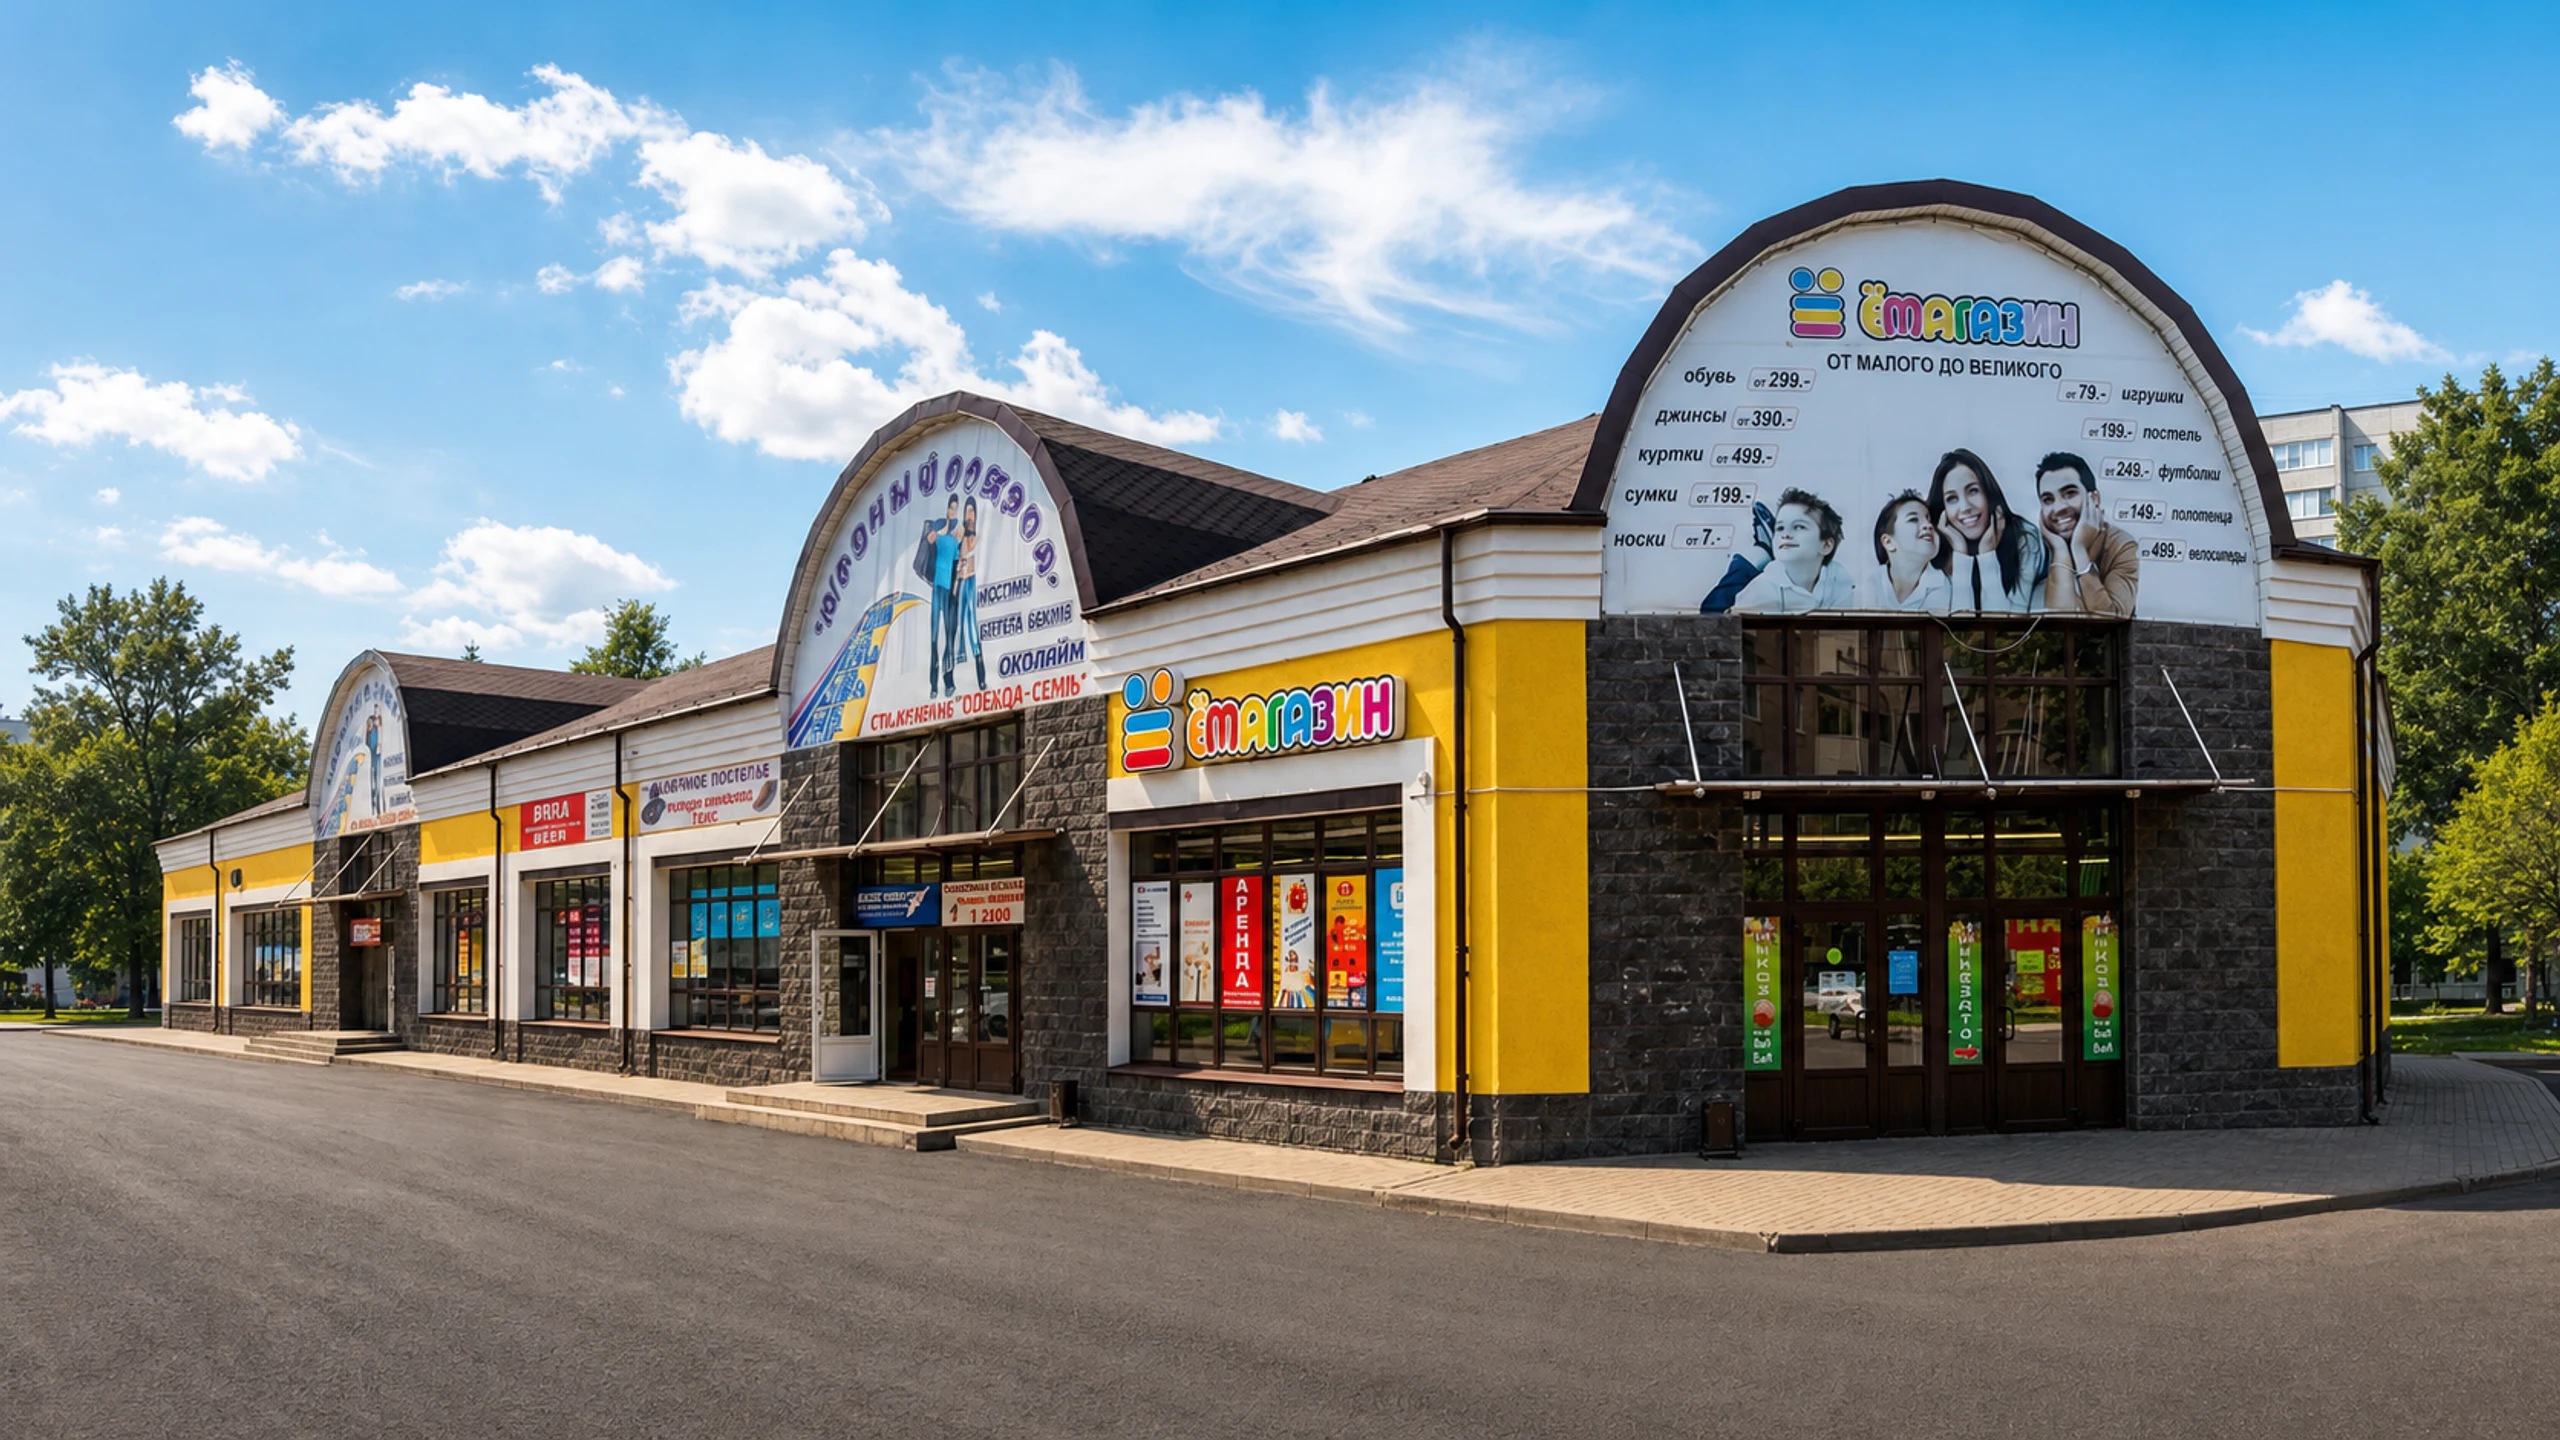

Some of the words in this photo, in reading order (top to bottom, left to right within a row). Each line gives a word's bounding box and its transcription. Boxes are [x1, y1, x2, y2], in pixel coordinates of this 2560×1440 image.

[1827, 353, 1852, 370] ОТ
[1857, 354, 1934, 373] МАЛОГО
[1939, 357, 1965, 377] ДО
[1970, 359, 2062, 380] ВЕЛИКОГО
[1684, 367, 1736, 387] обувь
[1753, 379, 1766, 388] от
[1769, 371, 1811, 389] 299.-
[2078, 384, 2107, 400] 79.-
[2122, 389, 2184, 406] игрушки
[1655, 409, 1727, 426] джинсы
[1737, 418, 1749, 427] от
[1751, 410, 1793, 428] 390.-
[2101, 423, 2133, 439] 199.-
[2142, 427, 2203, 442] постель
[1638, 448, 1704, 466] куртки
[1716, 455, 1728, 464] от
[1731, 447, 1773, 465] 499.-
[2116, 461, 2150, 478] 249.-
[2158, 464, 2221, 482] футболки
[1625, 488, 1678, 507] сумки
[1696, 495, 1709, 504] от
[2130, 503, 2162, 520] 149.-
[2172, 508, 2233, 526] полотенца
[1614, 533, 1666, 548] носки
[1686, 537, 1699, 546] от
[1235, 878, 1250, 988] АРЕНДА
